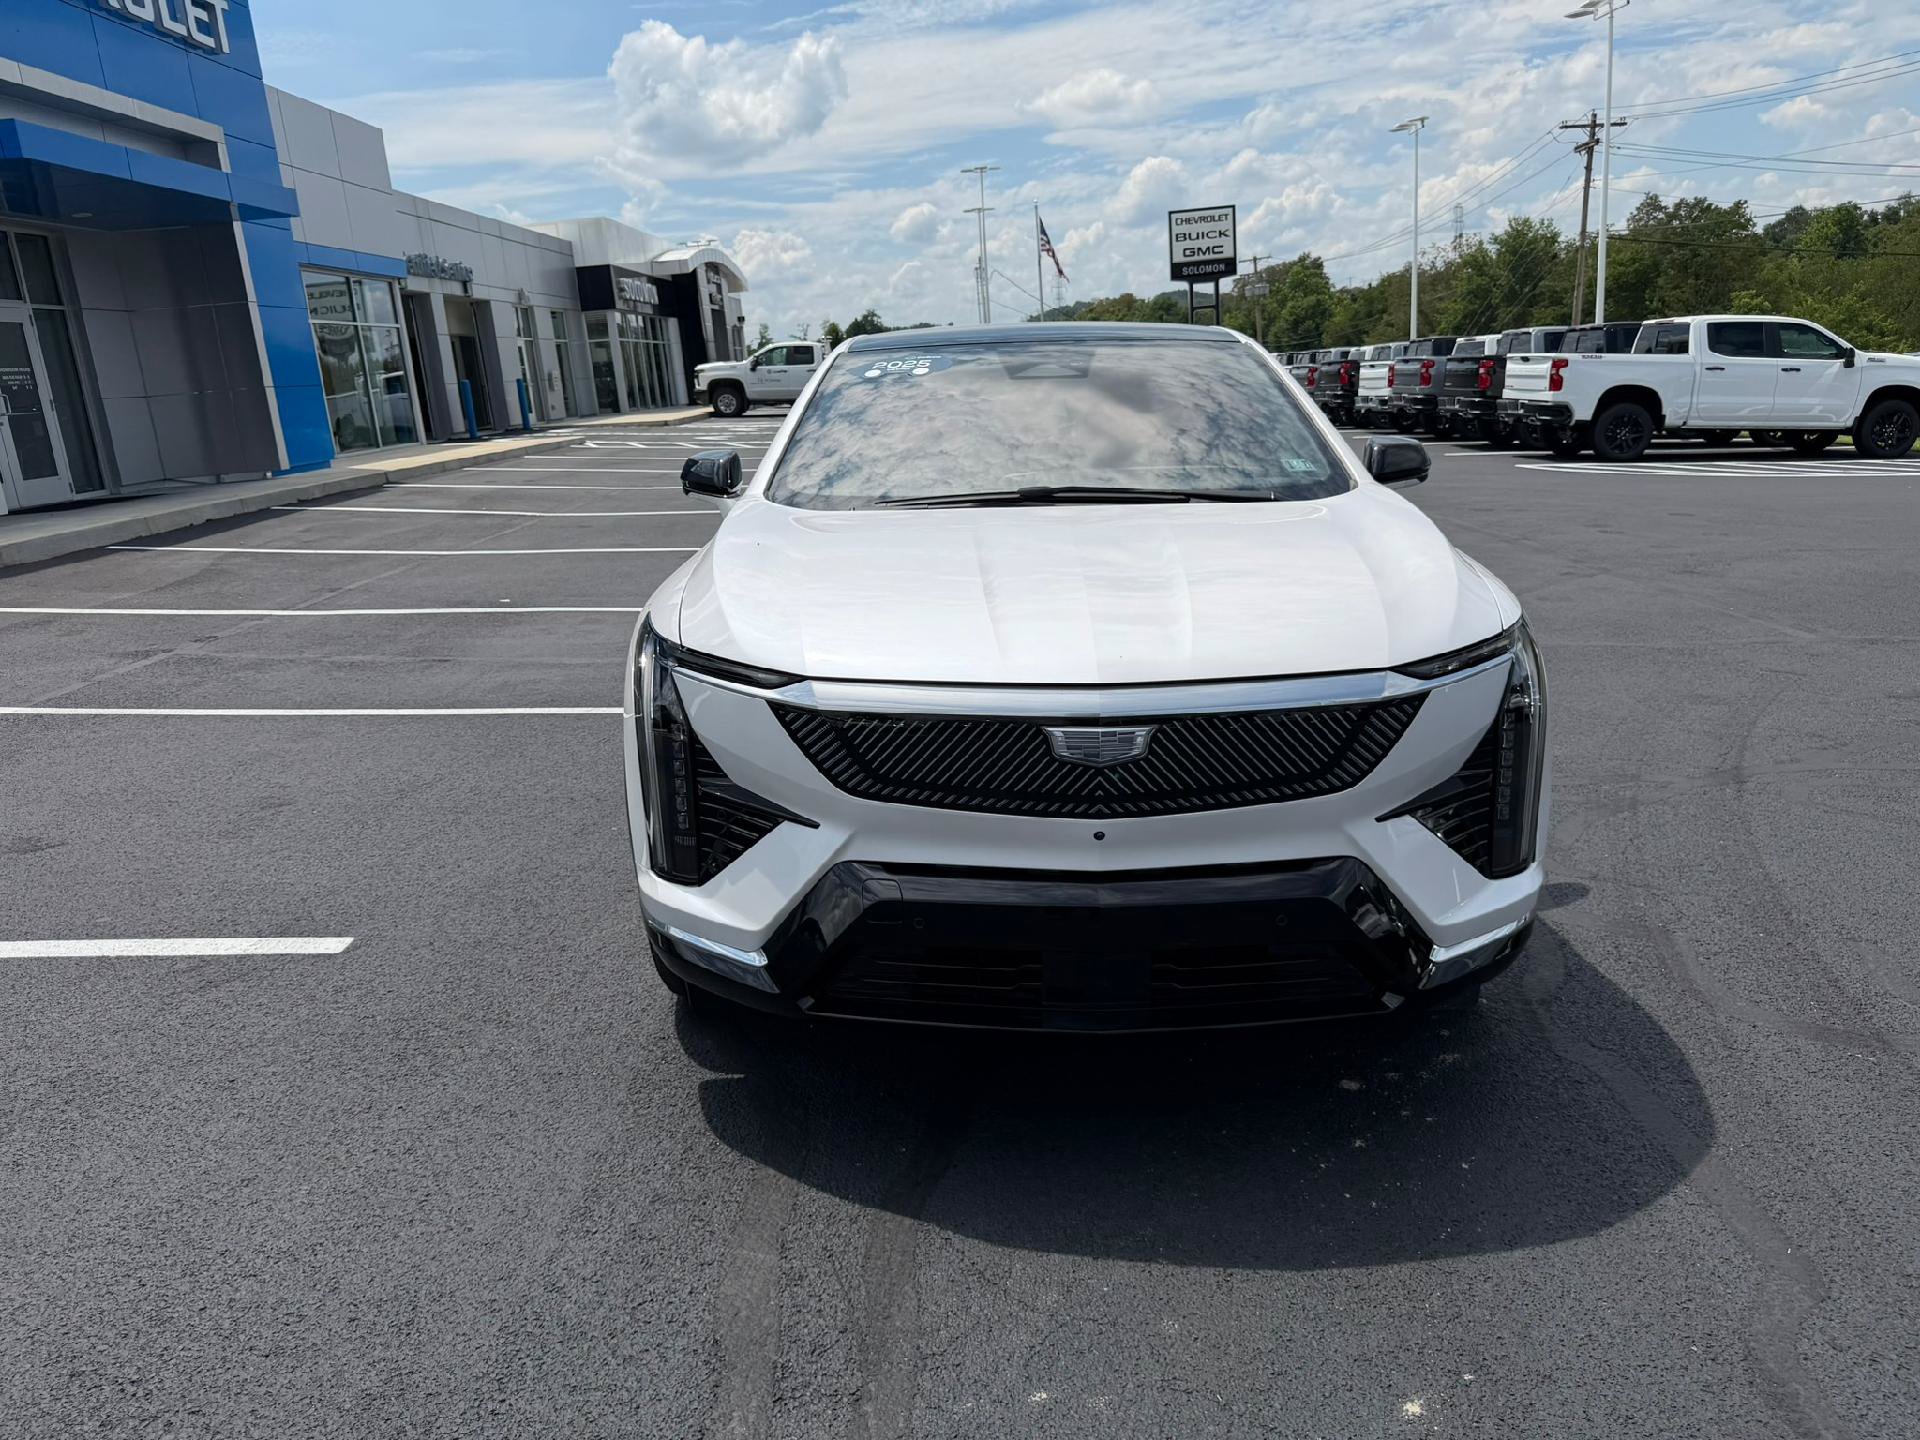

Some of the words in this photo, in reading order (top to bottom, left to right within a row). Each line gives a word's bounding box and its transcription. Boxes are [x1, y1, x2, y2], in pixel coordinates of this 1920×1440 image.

[1175, 213, 1230, 226] CHEVROLET
[1175, 229, 1230, 242] BUICK
[1183, 245, 1224, 258] GMC
[1182, 263, 1225, 276] SOLOMON
[872, 359, 932, 369] 2025
